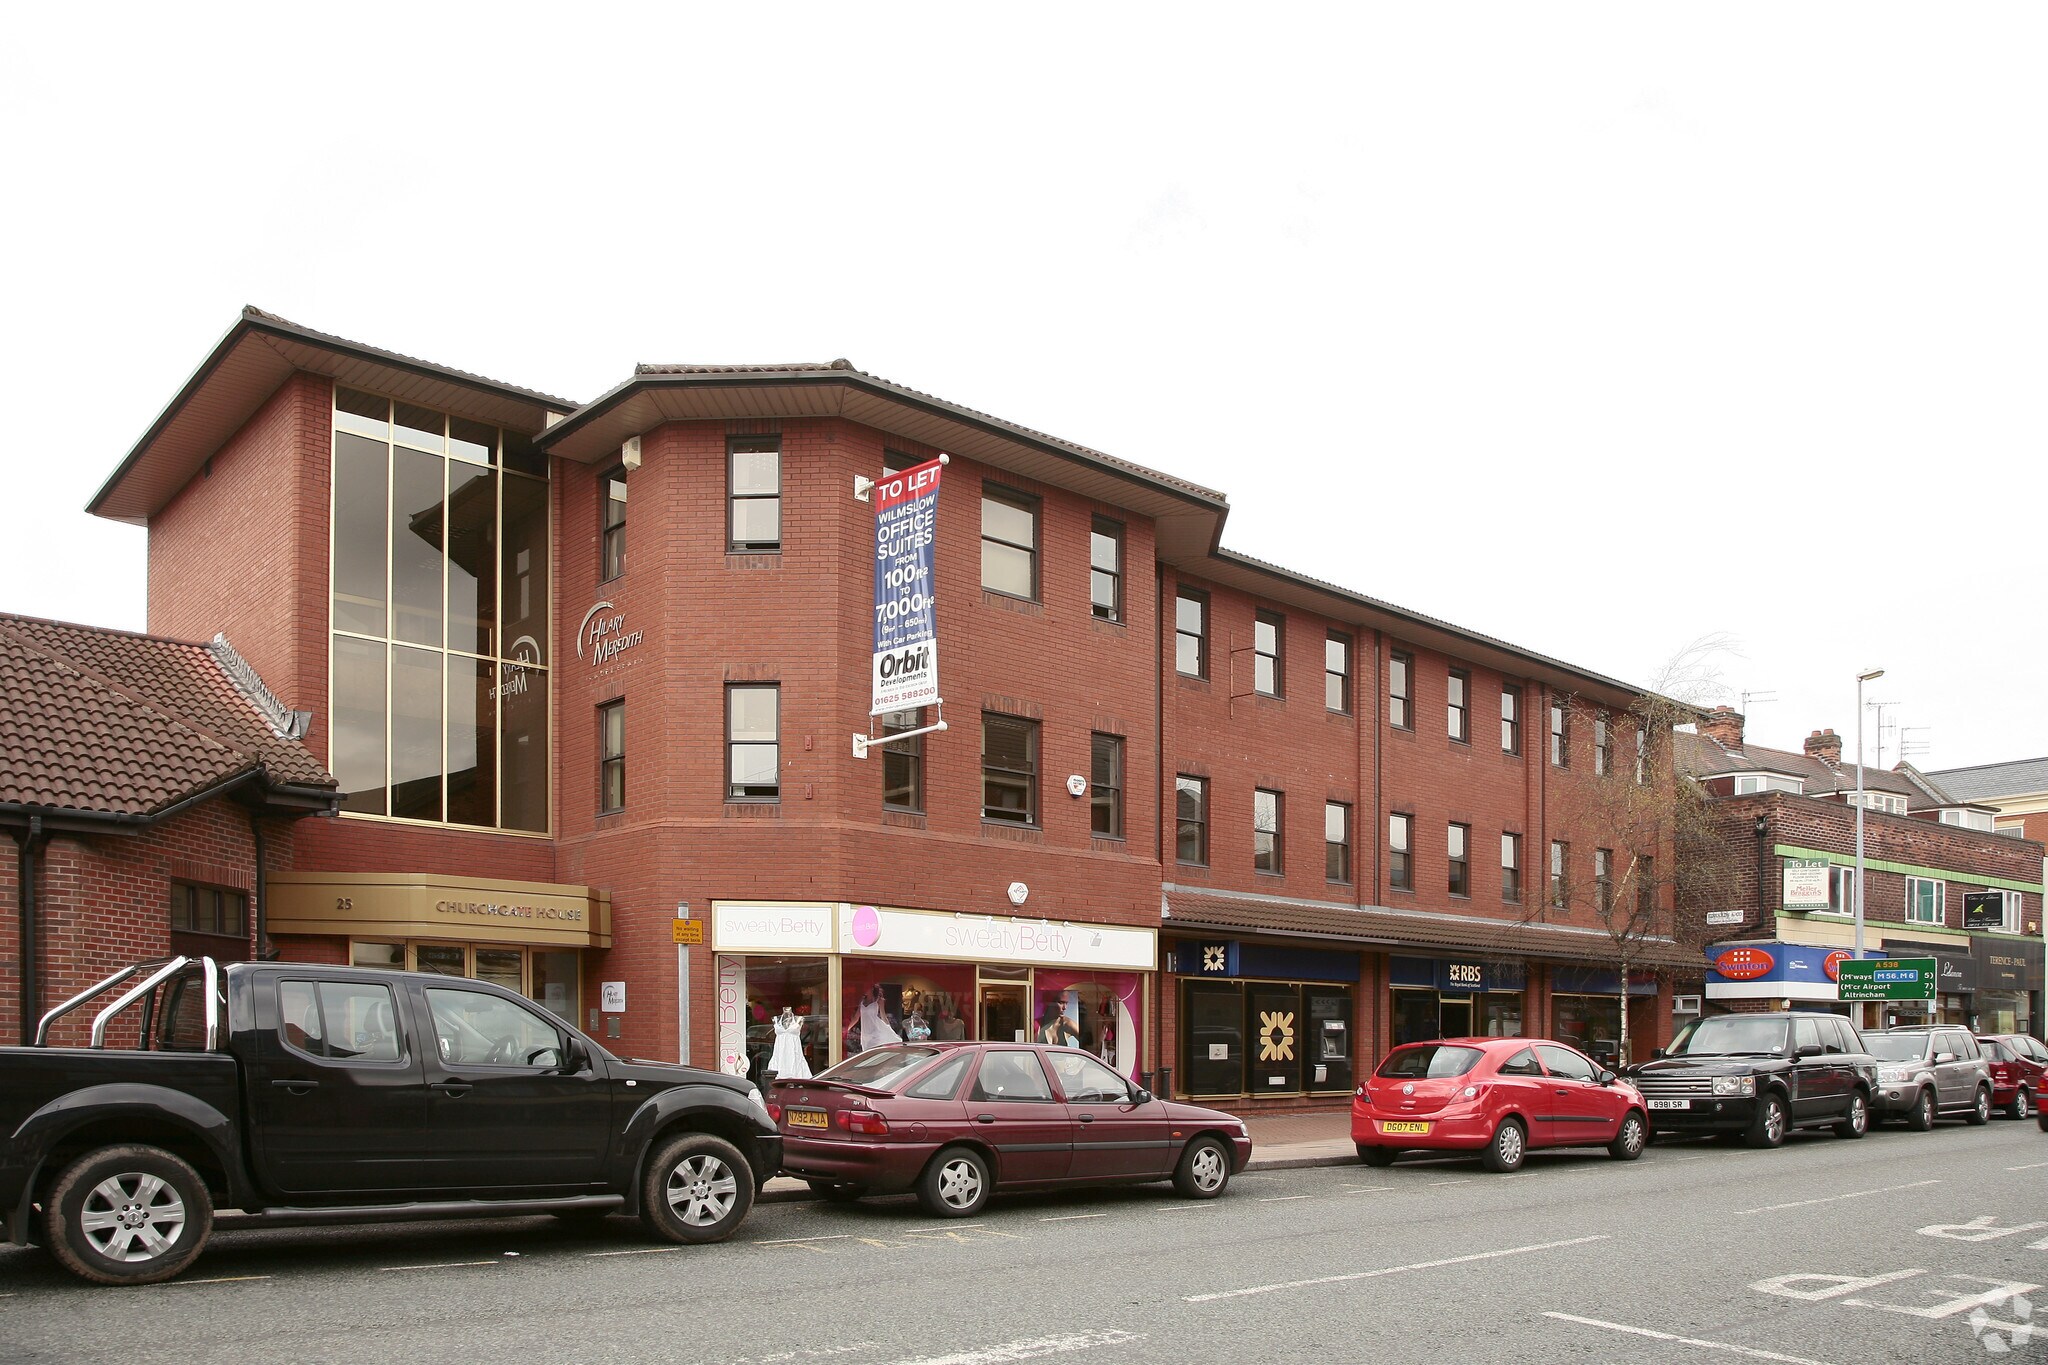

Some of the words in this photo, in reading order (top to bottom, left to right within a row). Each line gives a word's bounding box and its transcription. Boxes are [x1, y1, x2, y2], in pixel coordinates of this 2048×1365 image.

[879, 480, 903, 500] TO
[908, 465, 940, 492] LET
[878, 494, 935, 524] WILMSLOW
[878, 509, 934, 542] OFFICE
[878, 527, 933, 560] SUITES
[895, 553, 918, 566] FROM
[900, 586, 910, 595] TO
[593, 629, 643, 666] MEREDITH
[877, 640, 892, 649] With
[893, 636, 906, 645] Car
[906, 629, 933, 641] Parking
[880, 646, 930, 678] Orbit
[881, 672, 927, 687] Developments
[875, 694, 899, 705] 01625
[901, 687, 935, 700] 588200
[336, 898, 353, 910] 25
[436, 900, 532, 917] CHURCHGATE
[536, 905, 582, 921] HOUSE
[724, 917, 824, 936] sweatyBetty
[945, 925, 1073, 958] sweatyBetty
[1461, 965, 1481, 982] RBS
[1719, 961, 1769, 972] Swinton
[1386, 1123, 1408, 1132] DG07
[1409, 1123, 1426, 1132] ENL
